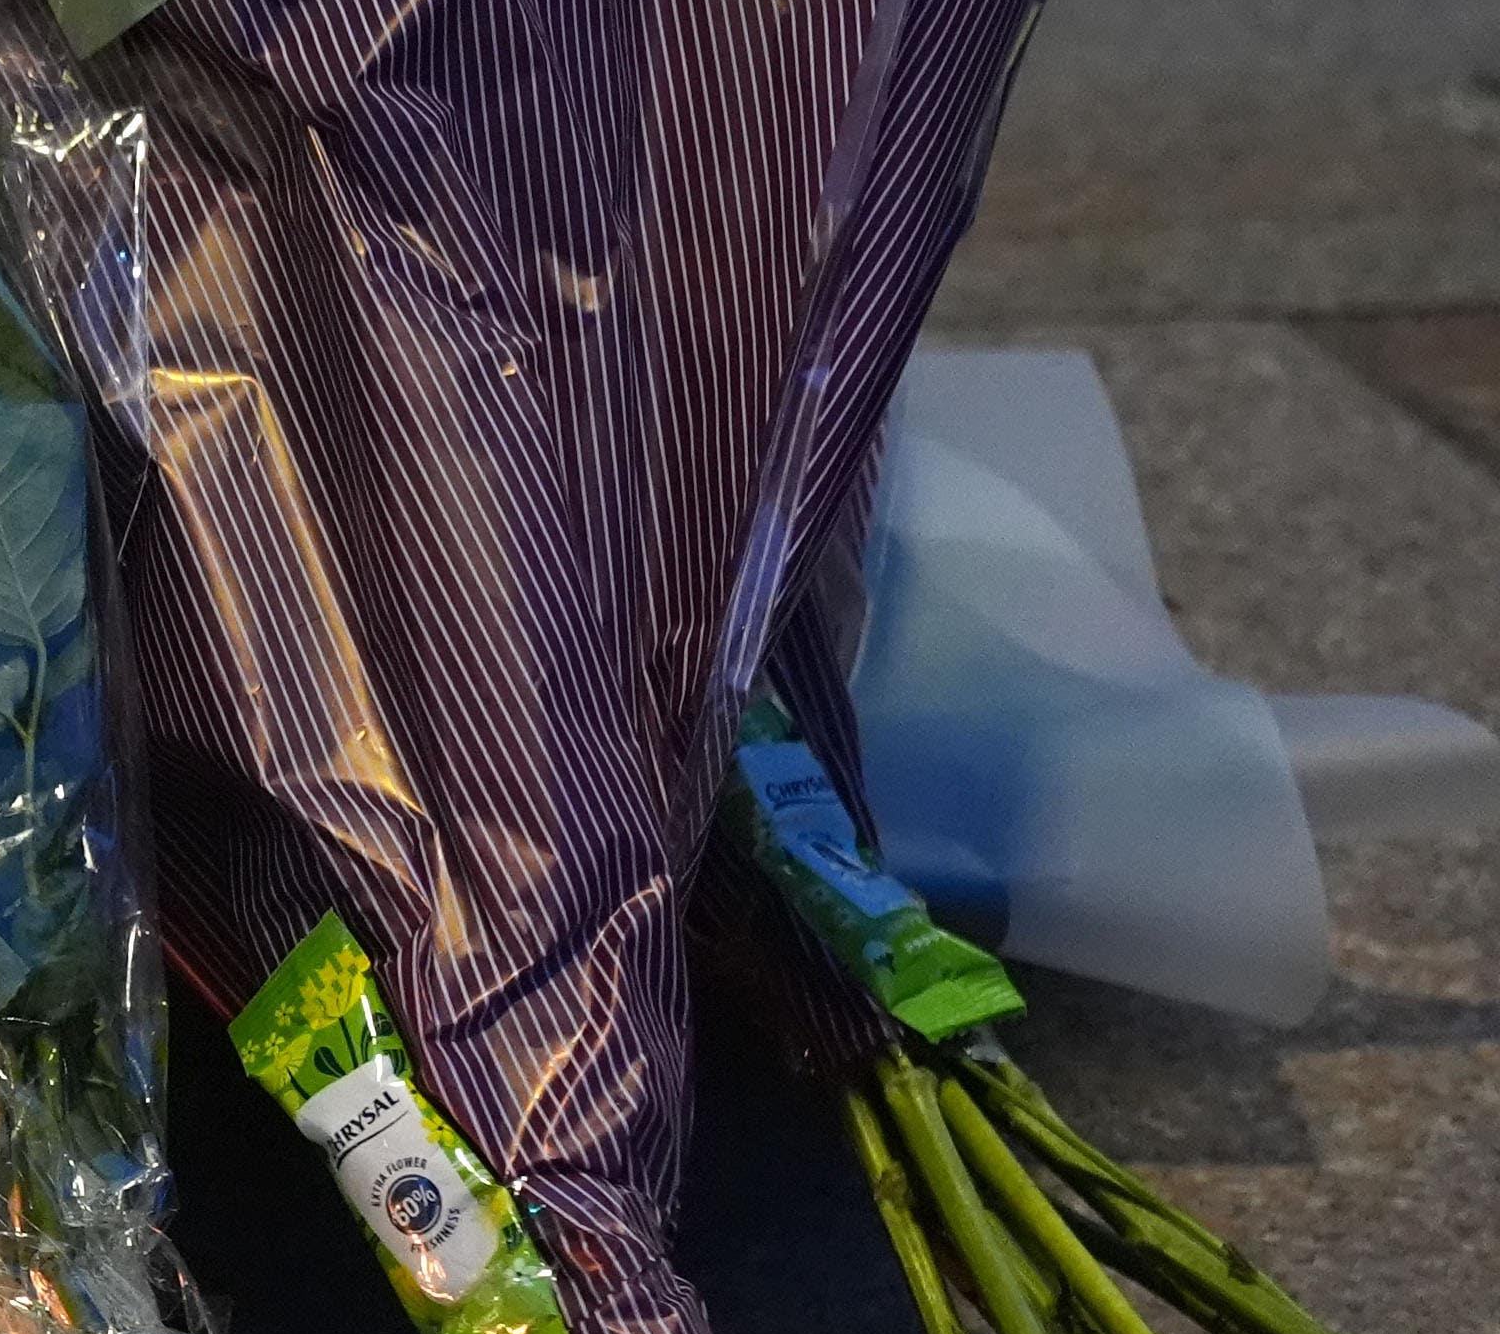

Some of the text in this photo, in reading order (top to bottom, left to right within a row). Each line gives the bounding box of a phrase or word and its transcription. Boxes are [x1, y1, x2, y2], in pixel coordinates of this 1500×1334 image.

[370, 1155, 429, 1208] EXTRA FLOWER
[391, 1183, 438, 1228] 60%
